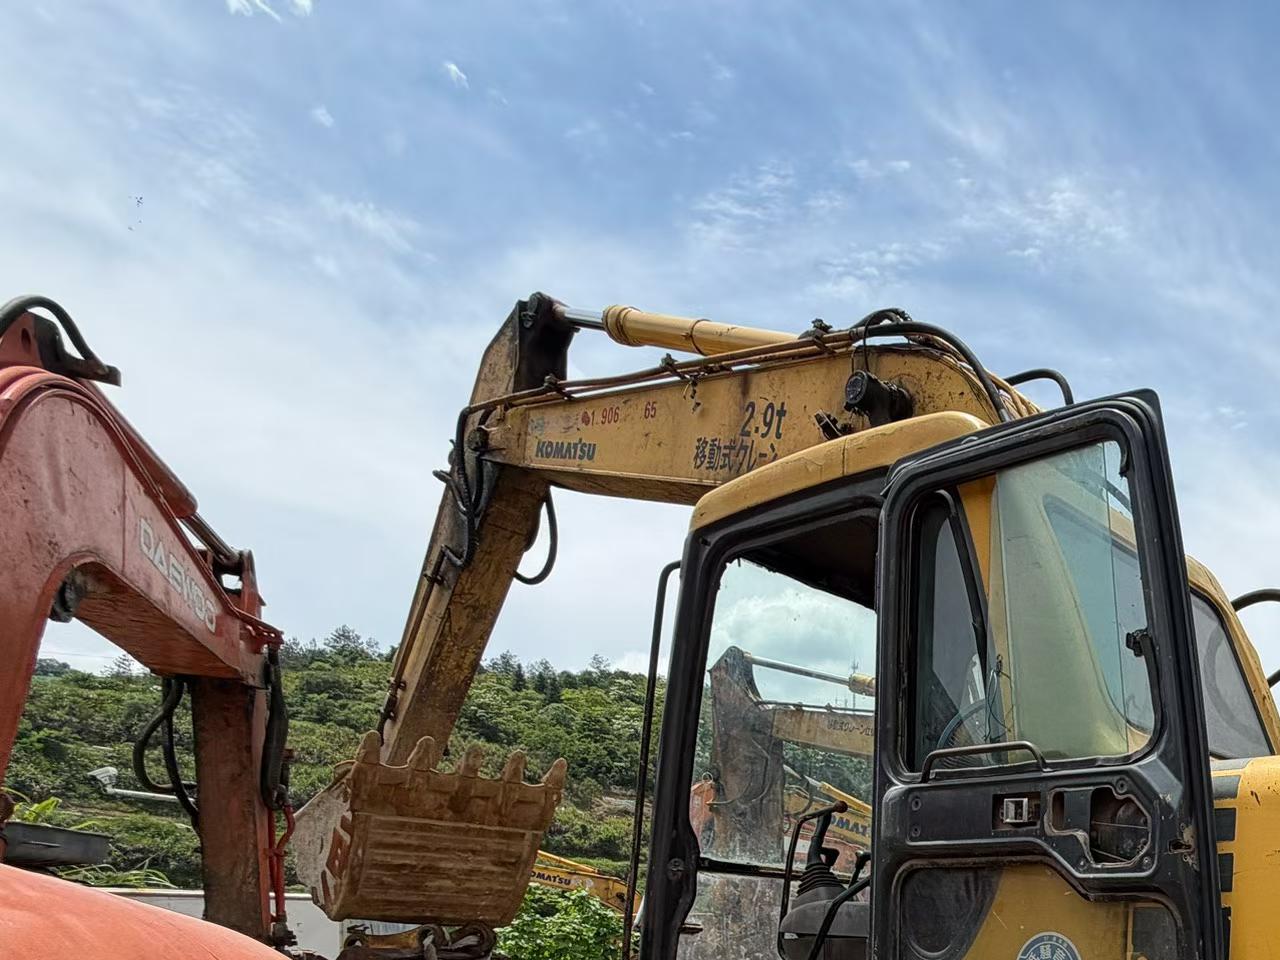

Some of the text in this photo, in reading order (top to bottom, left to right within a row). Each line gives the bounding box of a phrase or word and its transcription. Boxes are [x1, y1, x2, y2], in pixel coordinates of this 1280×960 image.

[740, 401, 787, 439] 2.9t
[536, 438, 596, 460] KOMATSU
[530, 869, 572, 886] OMATSU
